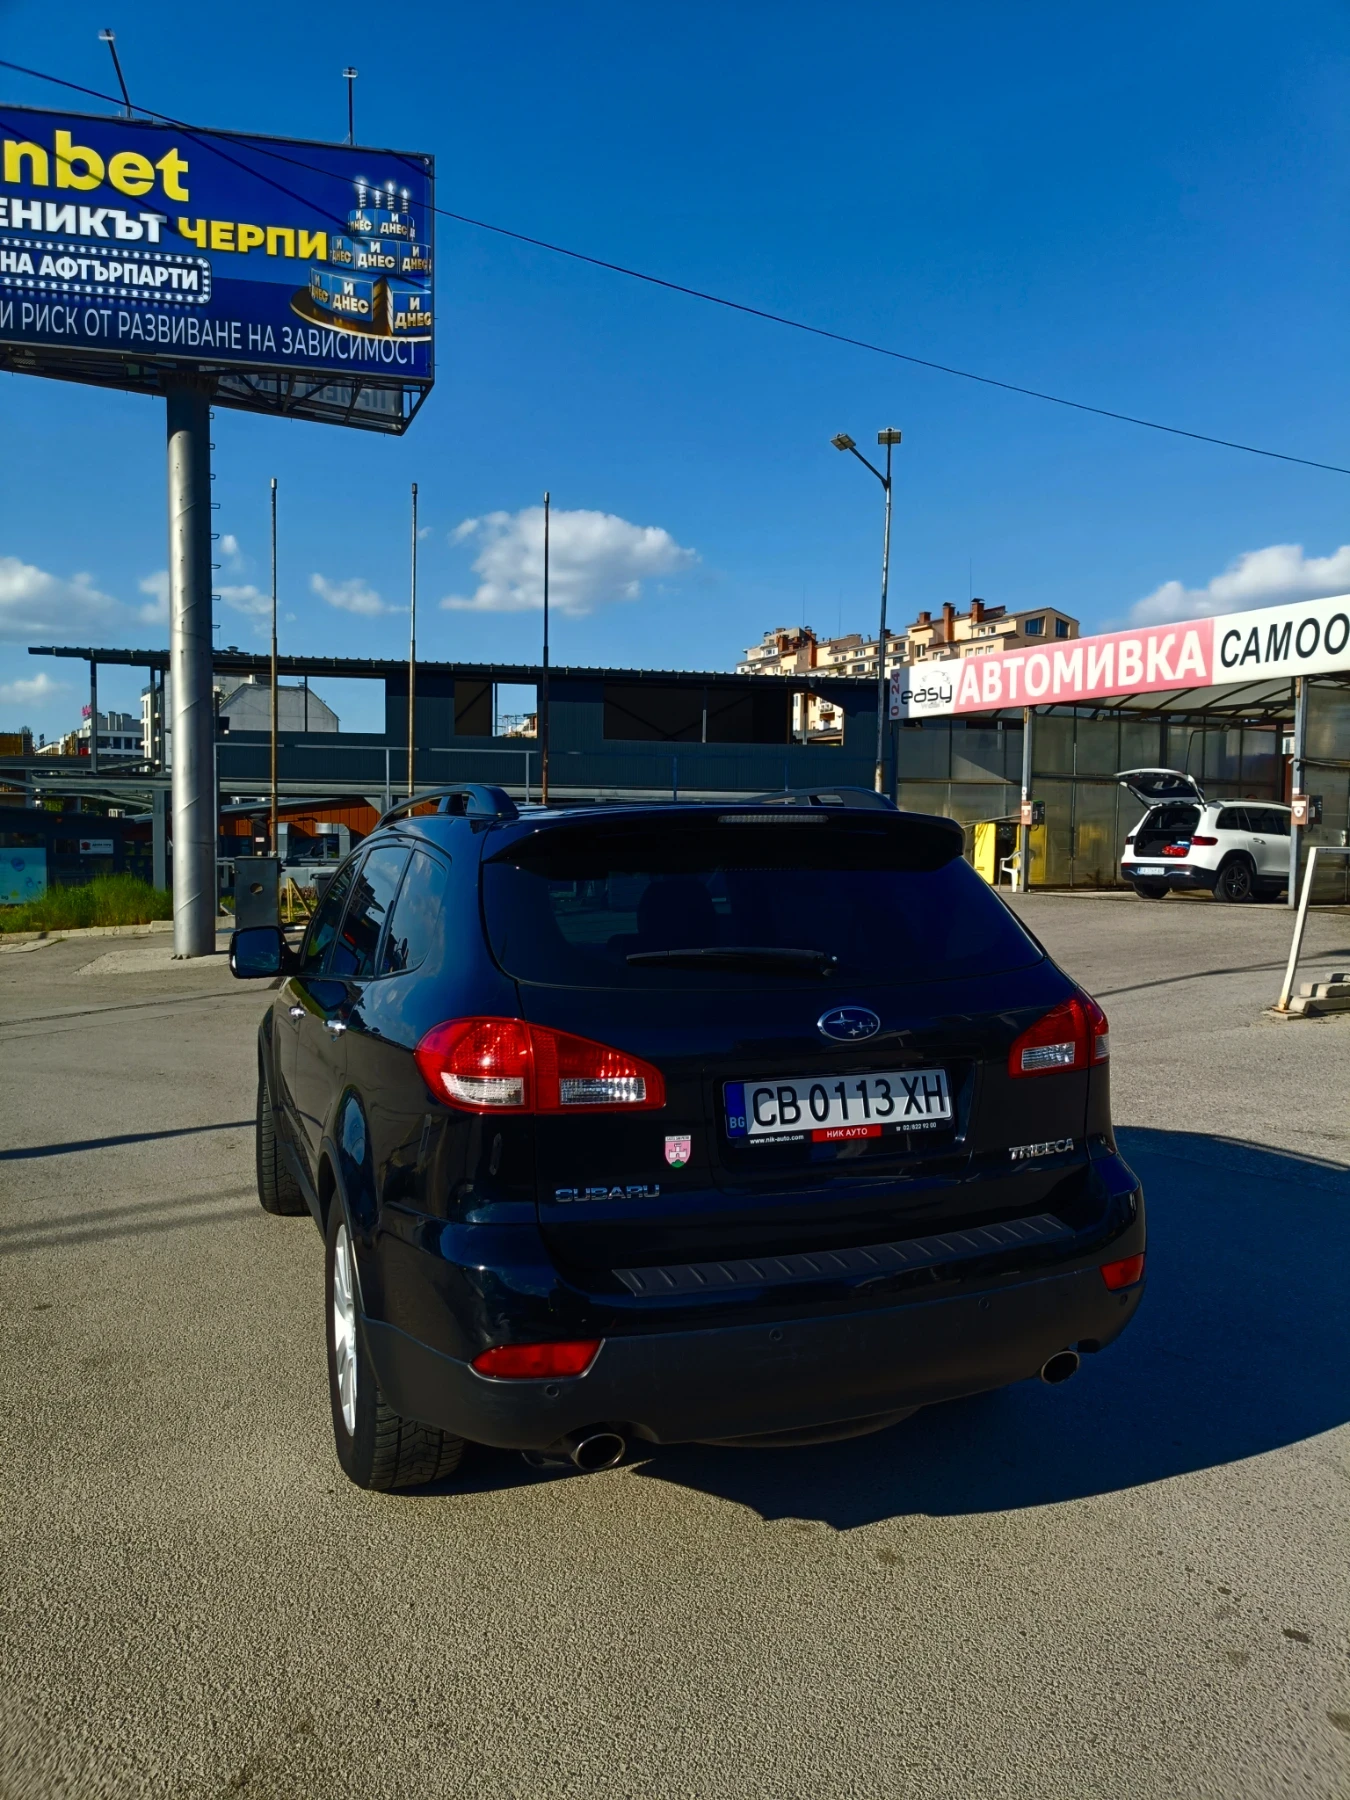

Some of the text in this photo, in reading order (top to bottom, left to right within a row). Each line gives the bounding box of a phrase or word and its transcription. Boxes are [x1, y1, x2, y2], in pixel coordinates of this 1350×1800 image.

[4, 130, 189, 202] nbet
[355, 210, 362, 220] И
[391, 212, 399, 223] И
[380, 222, 408, 236] ДНЕС
[178, 217, 327, 260] ЧЕРПИ
[336, 239, 343, 249] И
[370, 241, 381, 253] И
[412, 246, 420, 257] И
[357, 253, 396, 269] ДНЕС
[402, 257, 428, 271] ДНЕС
[0, 250, 198, 291] НА АФТЪРПАРТИ
[343, 281, 355, 296] И
[332, 293, 369, 314] ДНЕС
[409, 297, 420, 311] И
[394, 312, 432, 330] ДНЕС
[0, 301, 418, 366] И РИСК ОТ РАЗВИВАНЕ НА ЗАВИСИМОСТ
[959, 612, 1350, 705] АВТОМИВКА САМОО
[901, 684, 953, 704] easy
[808, 1079, 896, 1123] 0113
[730, 1116, 746, 1130] BG
[749, 1134, 805, 1145] www.nik-auto.com
[826, 1127, 868, 1139] НИК АУТО
[1008, 1138, 1074, 1160] TRIBECA
[555, 1184, 660, 1202] SUBARU
